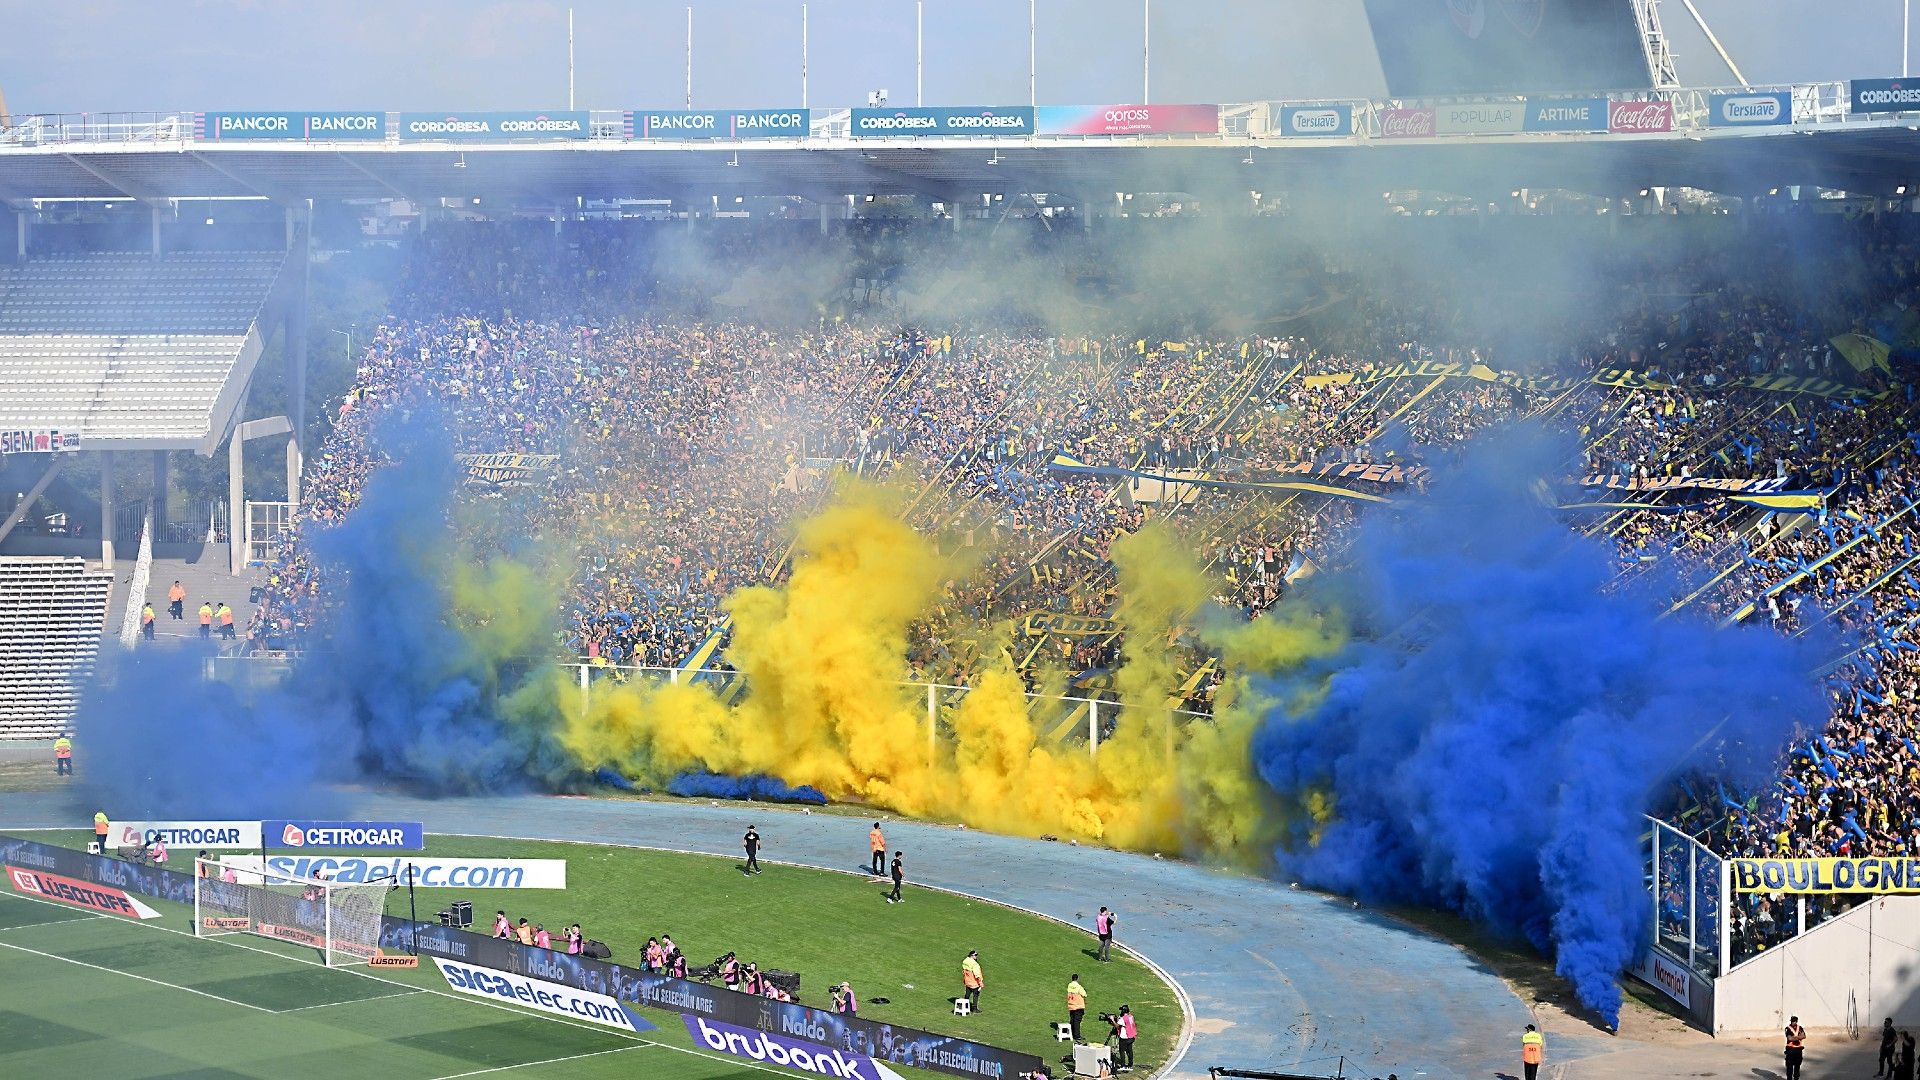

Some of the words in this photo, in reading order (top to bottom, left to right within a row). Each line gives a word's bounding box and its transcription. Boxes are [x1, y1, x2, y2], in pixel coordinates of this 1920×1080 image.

[1105, 110, 1149, 125] apross
[1451, 110, 1513, 123] POPULAR
[1538, 107, 1589, 121] ARTIME
[1728, 102, 1775, 117] Tersuave
[221, 116, 288, 131] BANCOR
[311, 116, 378, 130] BANCOR
[409, 120, 491, 133] CORDOBESA
[501, 119, 581, 132] CORDOBESA
[650, 115, 715, 129] BANCOR
[736, 113, 802, 128] BANCOR
[859, 117, 937, 129] CORDOBESA
[947, 116, 1025, 128] CORDOBESA
[1296, 113, 1336, 128] Tersuave
[468, 466, 535, 482] DIAMANTE
[144, 828, 240, 845] CETROGAR
[306, 828, 403, 845] CETROGAR
[99, 866, 127, 886] Naldo
[1736, 859, 1920, 891] BOULOGNE
[451, 942, 467, 957] ARGE
[528, 957, 565, 981] Naldo
[652, 987, 660, 1002] LA
[695, 997, 713, 1014] ARGE
[782, 1014, 826, 1041] Naldo
[698, 1017, 866, 1080] brubank
[929, 1048, 938, 1064] LA
[939, 1050, 979, 1073] SELECCIÓN
